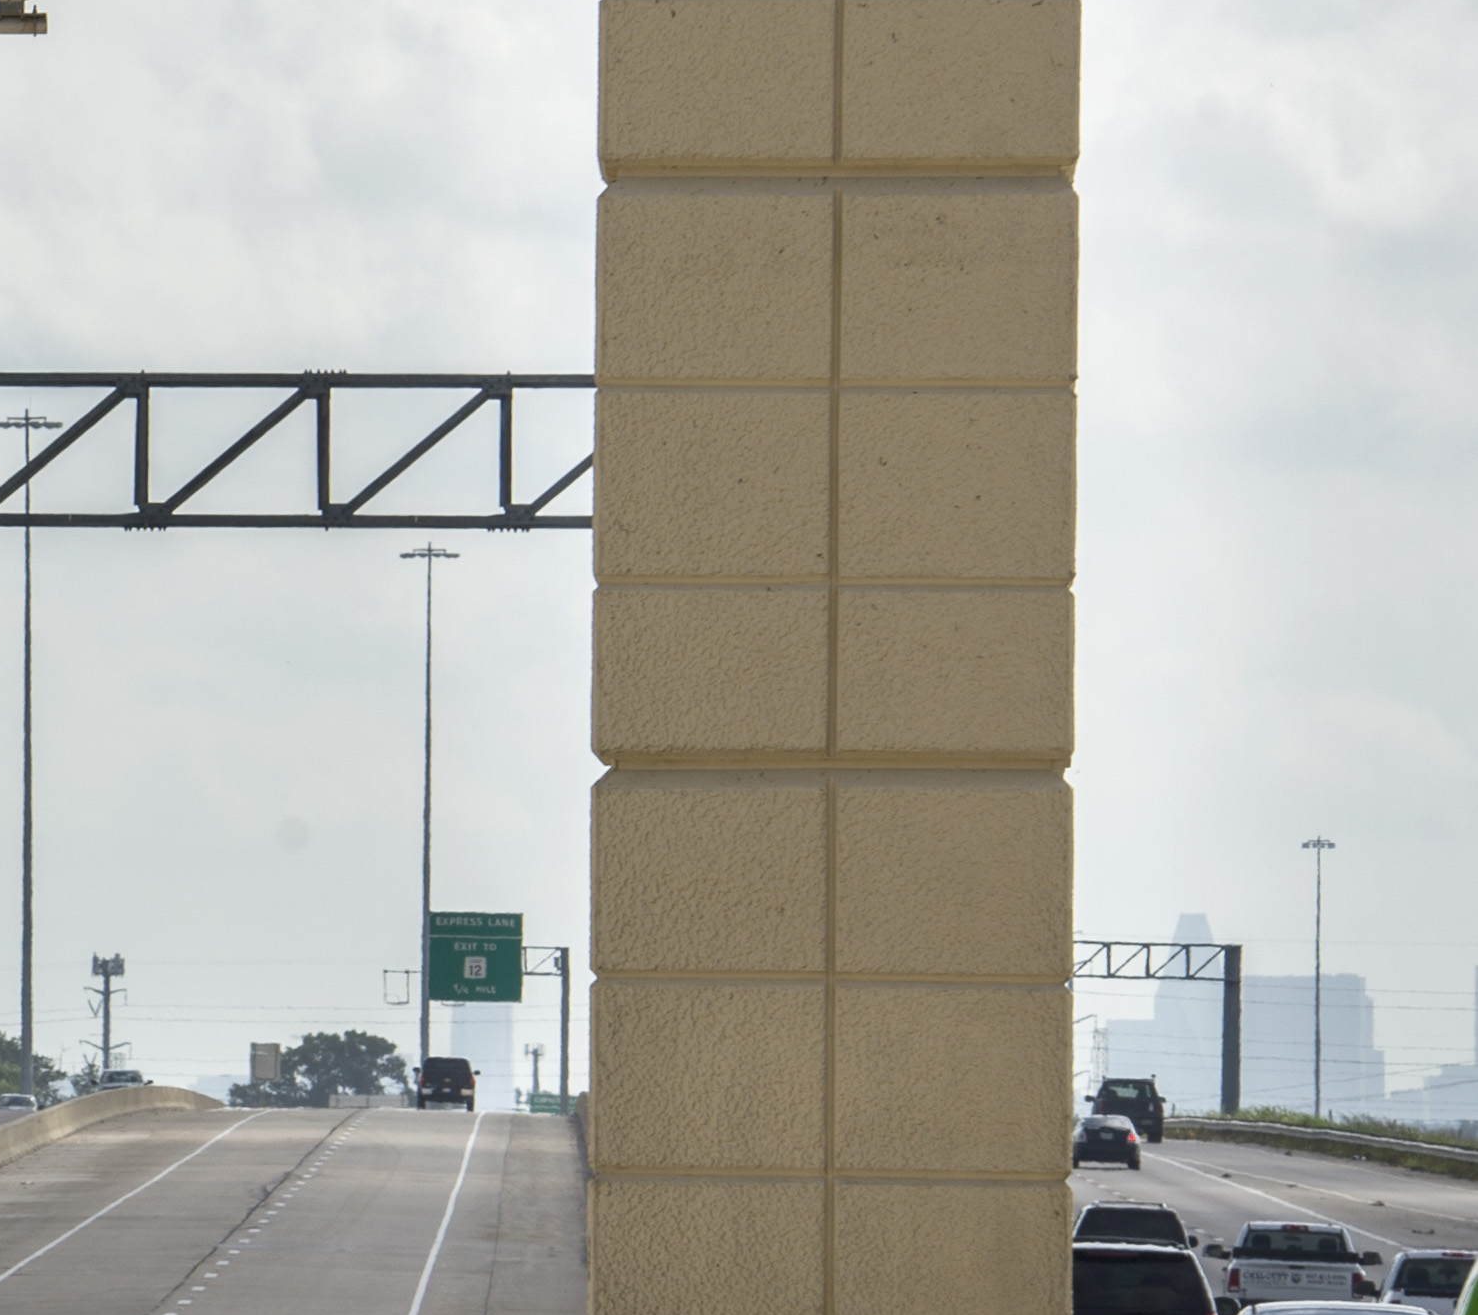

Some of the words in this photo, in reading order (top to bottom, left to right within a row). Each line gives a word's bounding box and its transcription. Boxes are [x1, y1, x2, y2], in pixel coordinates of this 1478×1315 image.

[435, 916, 484, 927] EXPRESS
[487, 918, 516, 927] LANE
[453, 941, 478, 951] EXIT
[483, 942, 497, 951] TO
[469, 964, 482, 977] 12
